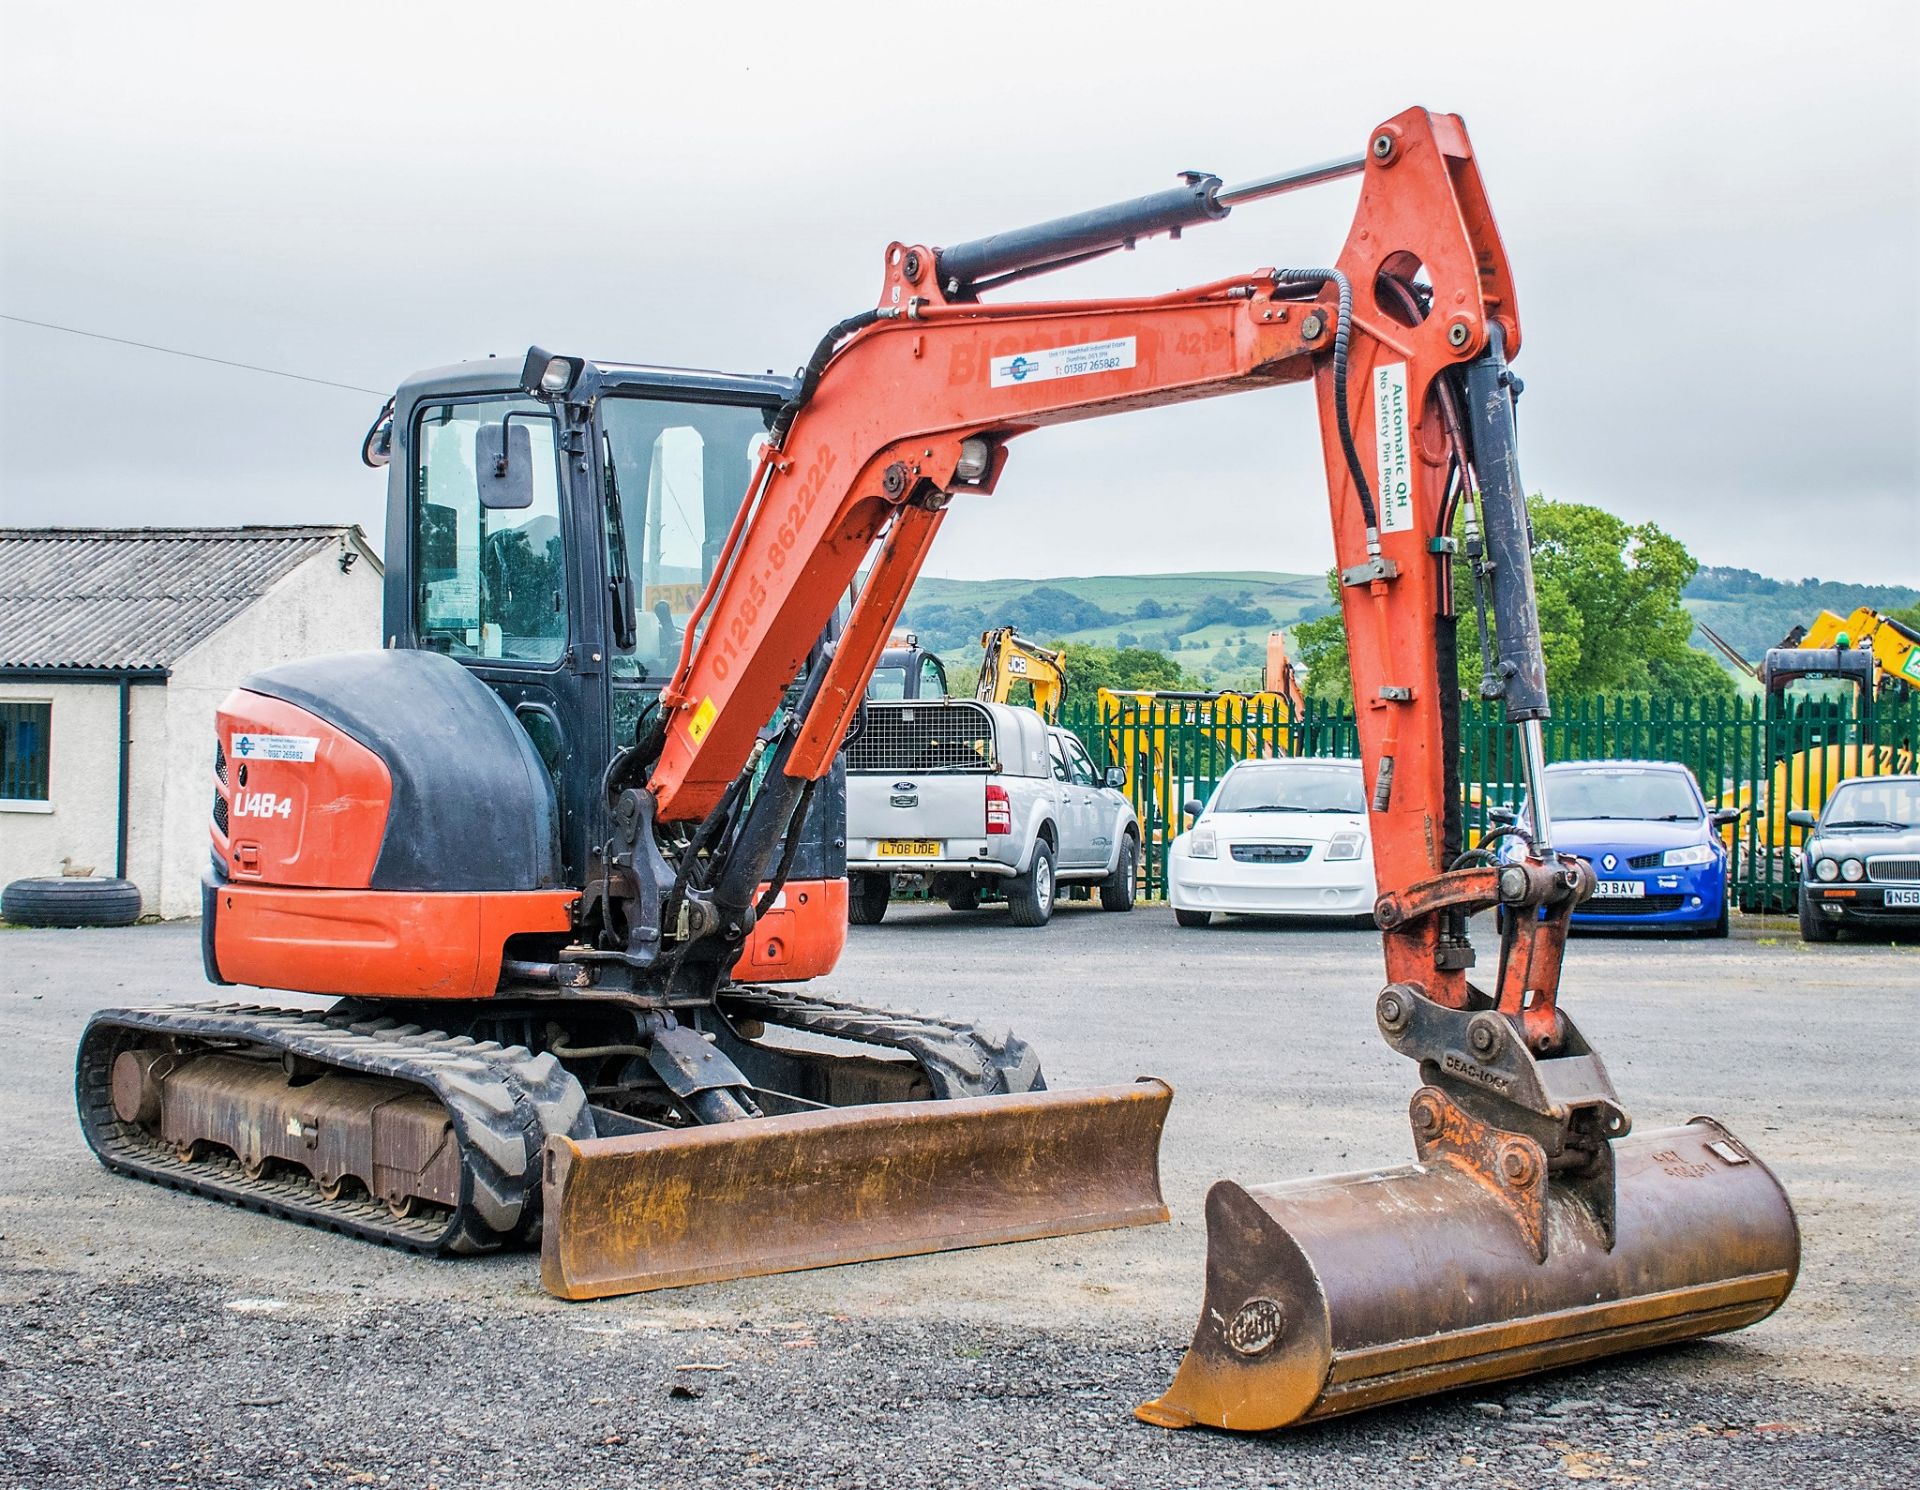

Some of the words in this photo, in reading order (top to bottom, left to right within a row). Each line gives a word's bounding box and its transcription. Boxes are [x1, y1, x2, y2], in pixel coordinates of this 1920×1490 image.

[1064, 361, 1087, 375] 01387
[1089, 357, 1120, 371] 265882
[1380, 371, 1388, 390] No
[1381, 395, 1389, 438] Safety
[1393, 384, 1406, 475] Automatic
[1383, 442, 1392, 463] Pin
[1383, 468, 1394, 527] Required
[1395, 482, 1407, 507] QH
[1008, 655, 1027, 674] JCB
[233, 792, 293, 819] U48-4
[913, 843, 935, 855] UDE
[1611, 882, 1636, 894] BAV
